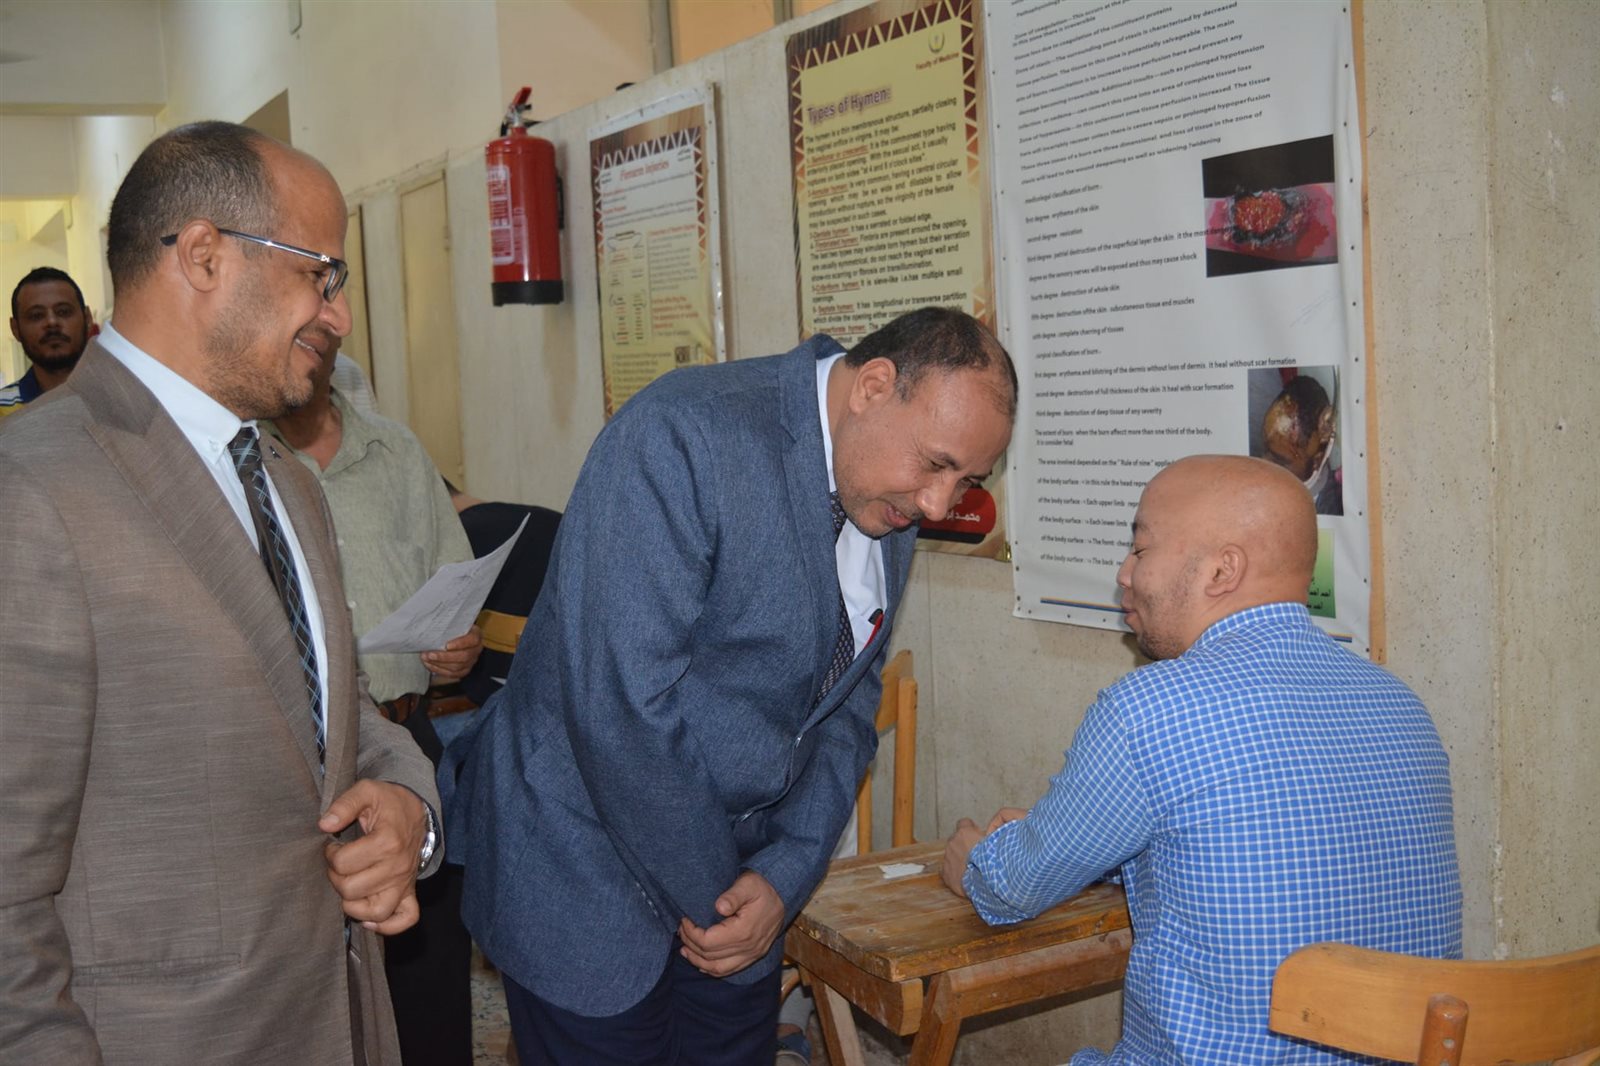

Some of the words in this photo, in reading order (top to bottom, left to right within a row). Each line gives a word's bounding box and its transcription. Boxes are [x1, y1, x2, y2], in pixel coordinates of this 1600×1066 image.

[1150, 15, 1192, 33] characterised
[1203, 1, 1238, 17] decreased
[1217, 19, 1235, 29] main
[1141, 54, 1171, 68] perfusion
[1172, 49, 1187, 58] here
[1188, 44, 1201, 53] and
[1202, 37, 1228, 50] prevent
[1230, 34, 1243, 42] any
[1184, 55, 1219, 71] prolonged
[1220, 44, 1265, 60] hypotension
[1139, 90, 1151, 98] into
[1161, 84, 1175, 92] area
[1184, 74, 1215, 86] complete
[1216, 68, 1236, 78] tissue
[1237, 64, 1252, 72] loss
[1141, 104, 1159, 113] tissue
[1160, 96, 1192, 109] perfusion
[1249, 76, 1271, 86] tissue
[807, 104, 835, 126] Types
[838, 96, 849, 115] of
[851, 88, 891, 113] Hymen:
[1133, 121, 1153, 130] severe
[1154, 116, 1173, 125] sepsis
[1182, 104, 1216, 119] prolonged
[1217, 93, 1271, 110] hypoperfusion
[1159, 131, 1172, 139] and
[1194, 122, 1213, 131] tissue
[1235, 114, 1253, 122] zone
[1254, 110, 1263, 118] of
